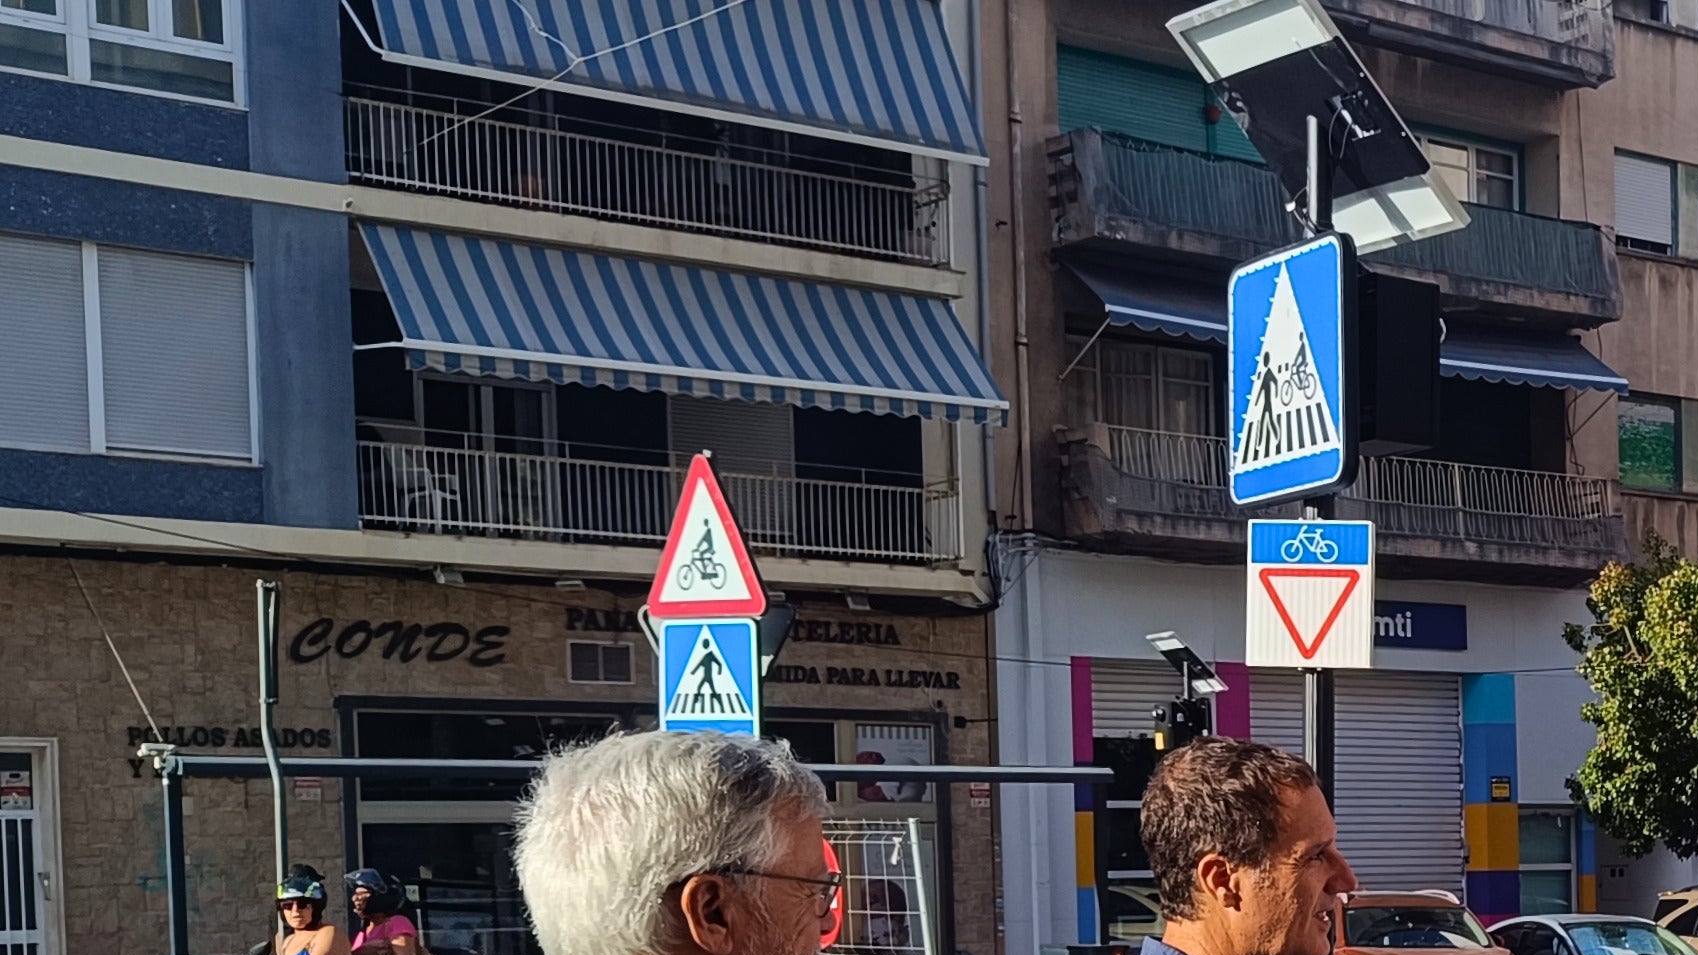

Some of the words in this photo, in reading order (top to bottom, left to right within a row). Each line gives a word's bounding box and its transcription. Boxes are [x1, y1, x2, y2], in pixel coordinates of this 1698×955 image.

[290, 617, 511, 667] CONDE
[827, 667, 880, 687] PARA
[884, 669, 961, 690] LLEVAR
